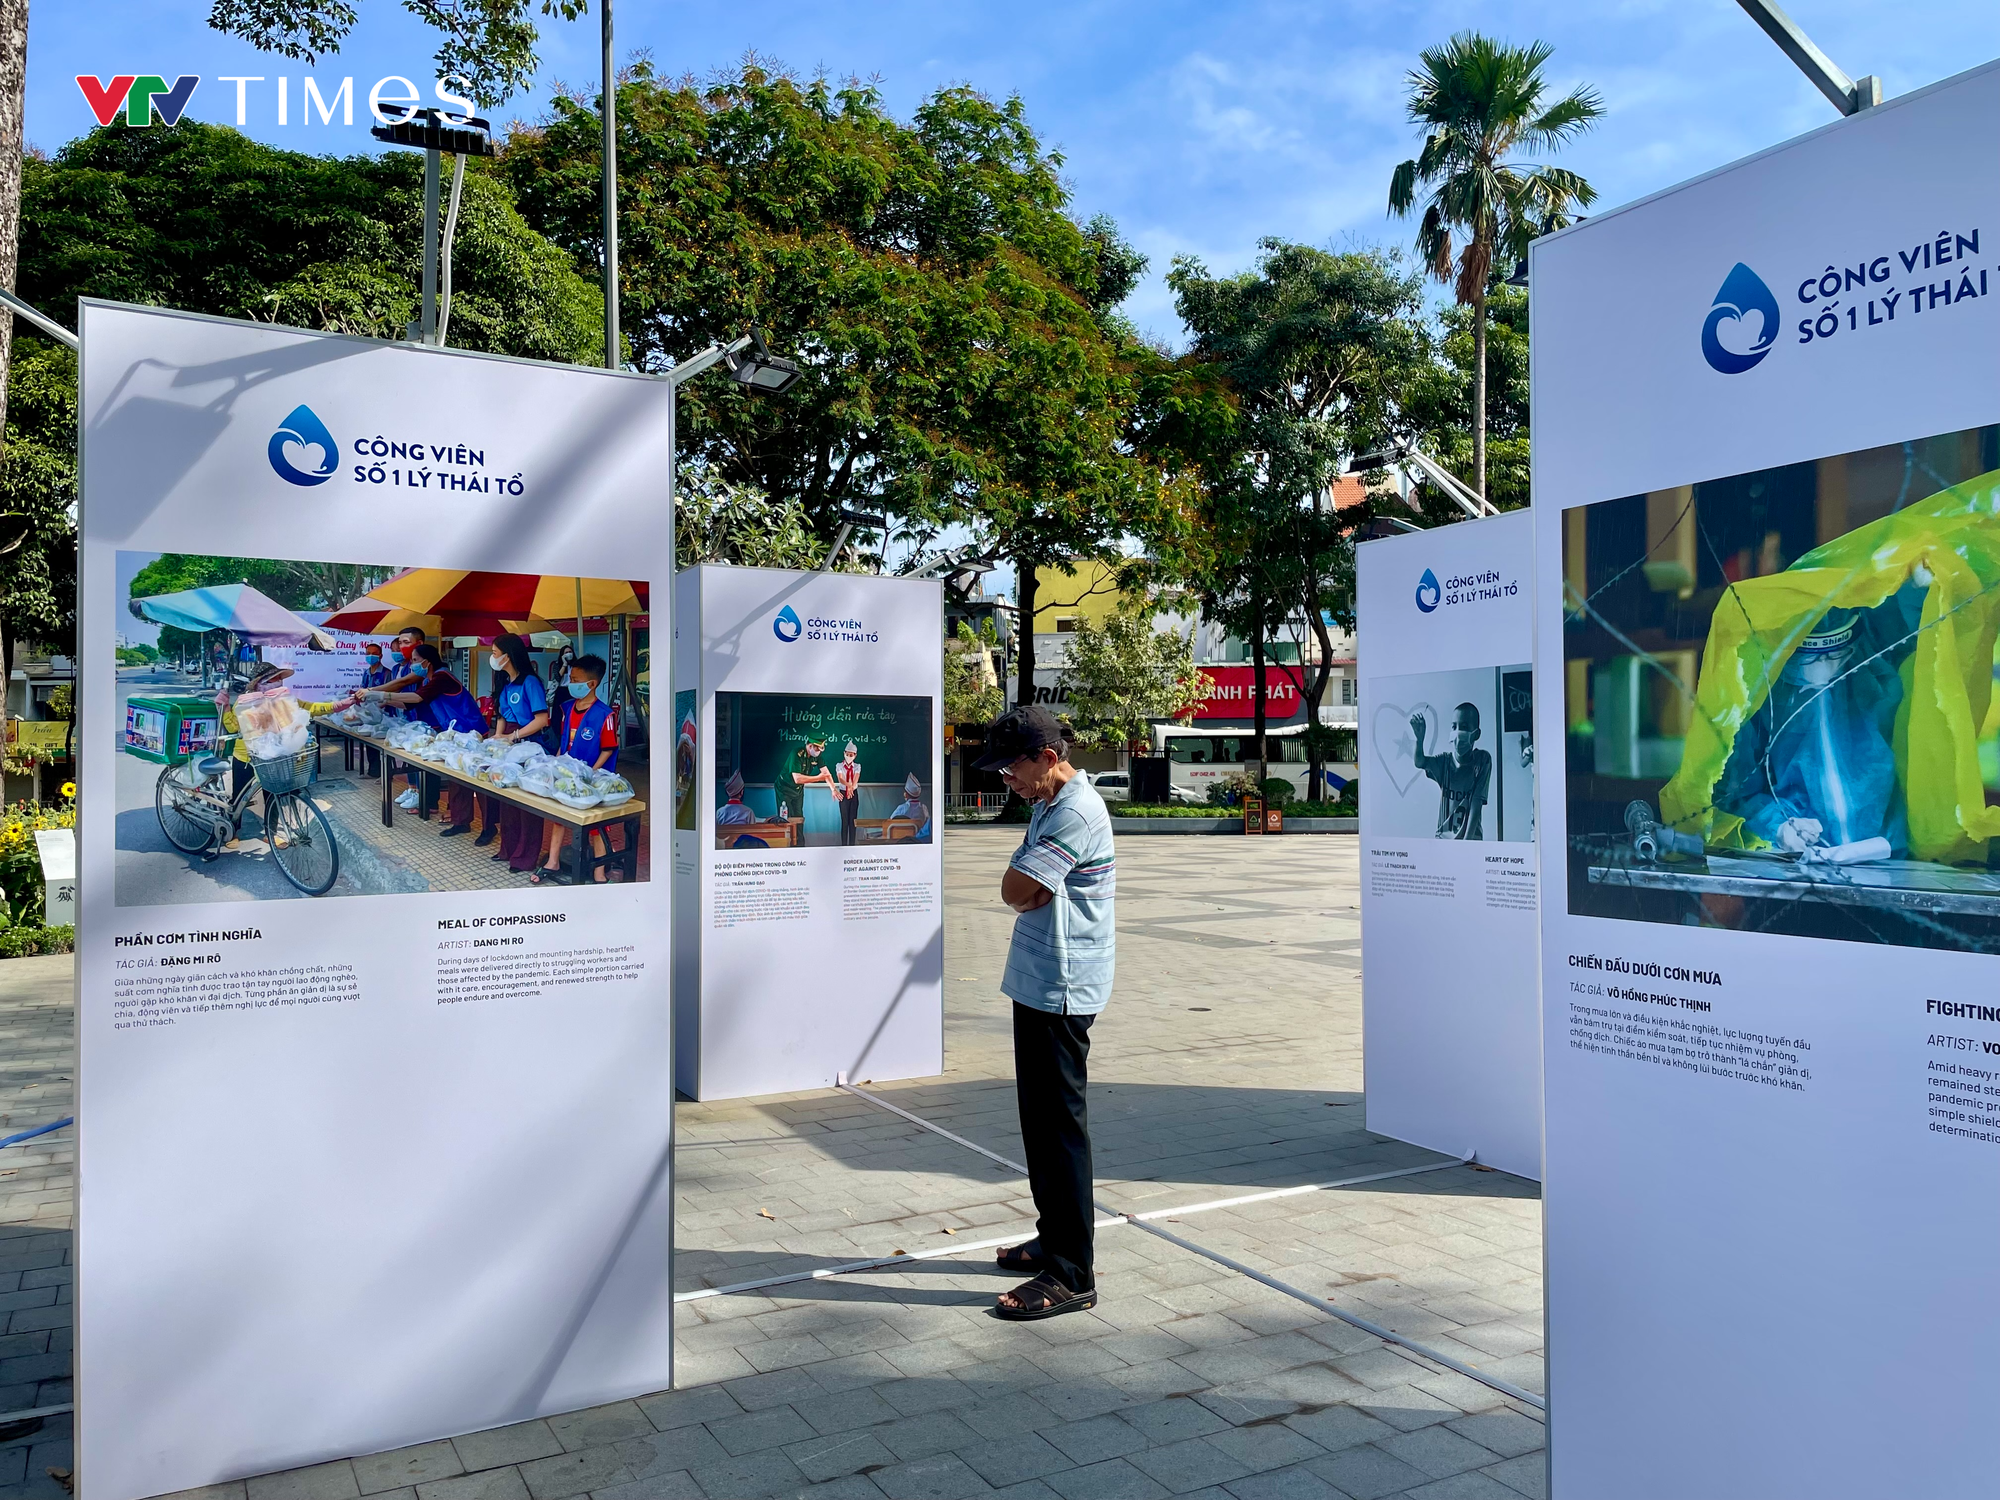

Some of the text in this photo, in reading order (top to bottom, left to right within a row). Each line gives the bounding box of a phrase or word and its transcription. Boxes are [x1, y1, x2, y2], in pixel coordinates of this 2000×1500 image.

[1798, 229, 1979, 303] CÔNG VIÊN
[1799, 264, 1987, 343] SỐ 1 LÝ THÁI
[354, 435, 484, 466] CÔNG VIÊN
[355, 461, 524, 495] SỐ 1 LÝ THÁI TỔ
[1446, 570, 1499, 590] CÔNG VIÊN
[1446, 580, 1517, 605] SỐ 1 LÝ THÁI TỔ
[808, 617, 861, 629] CÔNG VIÊN
[808, 629, 820, 639] SỐ
[830, 631, 839, 640] LÝ
[842, 632, 863, 641] THÁI
[866, 631, 878, 642] TỔ
[1822, 632, 1849, 646] Shield
[878, 709, 897, 724] tay
[437, 913, 566, 929] MEAL OF COMPASSIONS
[114, 926, 261, 947] PHẦN CƠM TÌNH NGHĨA
[437, 936, 523, 949] ARTIST: DANG MI RO
[115, 952, 221, 969] TÁC GIẢ: ĐẶNG MI RÔ
[437, 944, 634, 966] During days of lockdown and mounting hardship, heartfelt
[114, 962, 352, 986] Giữa những ngày giãn cách và khó khăn chồng chất, những
[1568, 953, 1722, 985] CHIẾN ĐẤU DƯỚI CƠN MƯA
[1569, 981, 1710, 1011] TÁC GIẢ: VÕ HỒNG PHÚC THỊNH
[1570, 1002, 1810, 1049] Trong mưa lớn và điều kiện khắc nghiệt, lực lượng tuyến đầu
[1927, 1034, 1978, 1052] ARTIST:
[1927, 1060, 1956, 1073] Amid
[1958, 1064, 1991, 1081] heavy
[1928, 1077, 1980, 1093] remained
[1928, 1092, 1983, 1108] pandemic
[1928, 1106, 1965, 1121] simple
